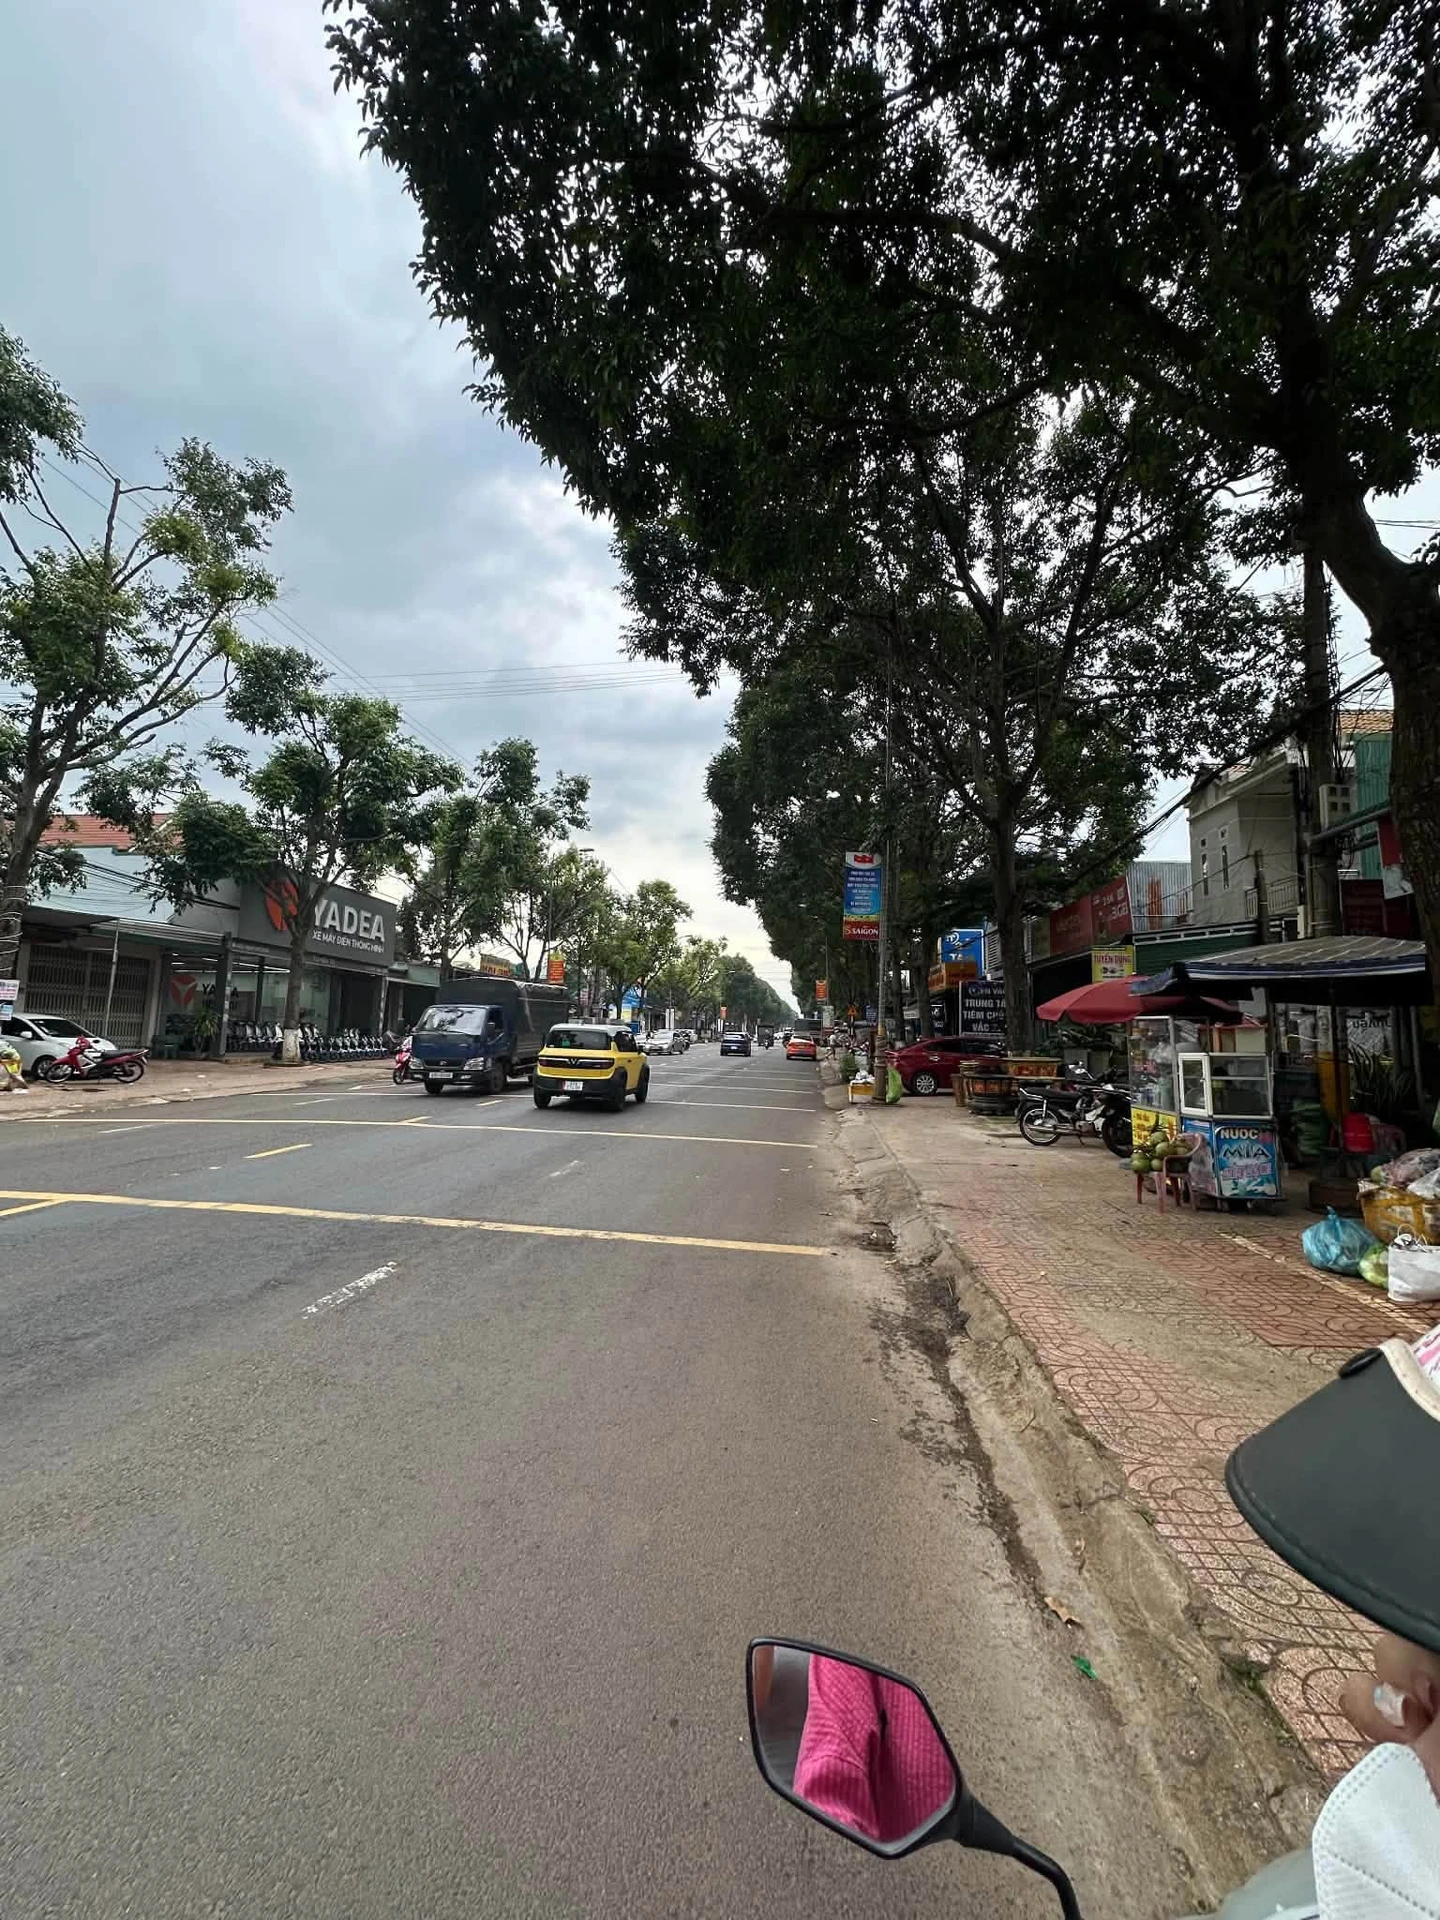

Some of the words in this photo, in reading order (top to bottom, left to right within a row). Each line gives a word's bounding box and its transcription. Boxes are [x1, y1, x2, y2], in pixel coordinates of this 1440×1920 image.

[314, 899, 385, 942] YADEA
[312, 929, 322, 941] XE
[852, 927, 878, 935] SAIGON
[203, 983, 239, 998] YAA
[964, 999, 994, 1008] TRUNG
